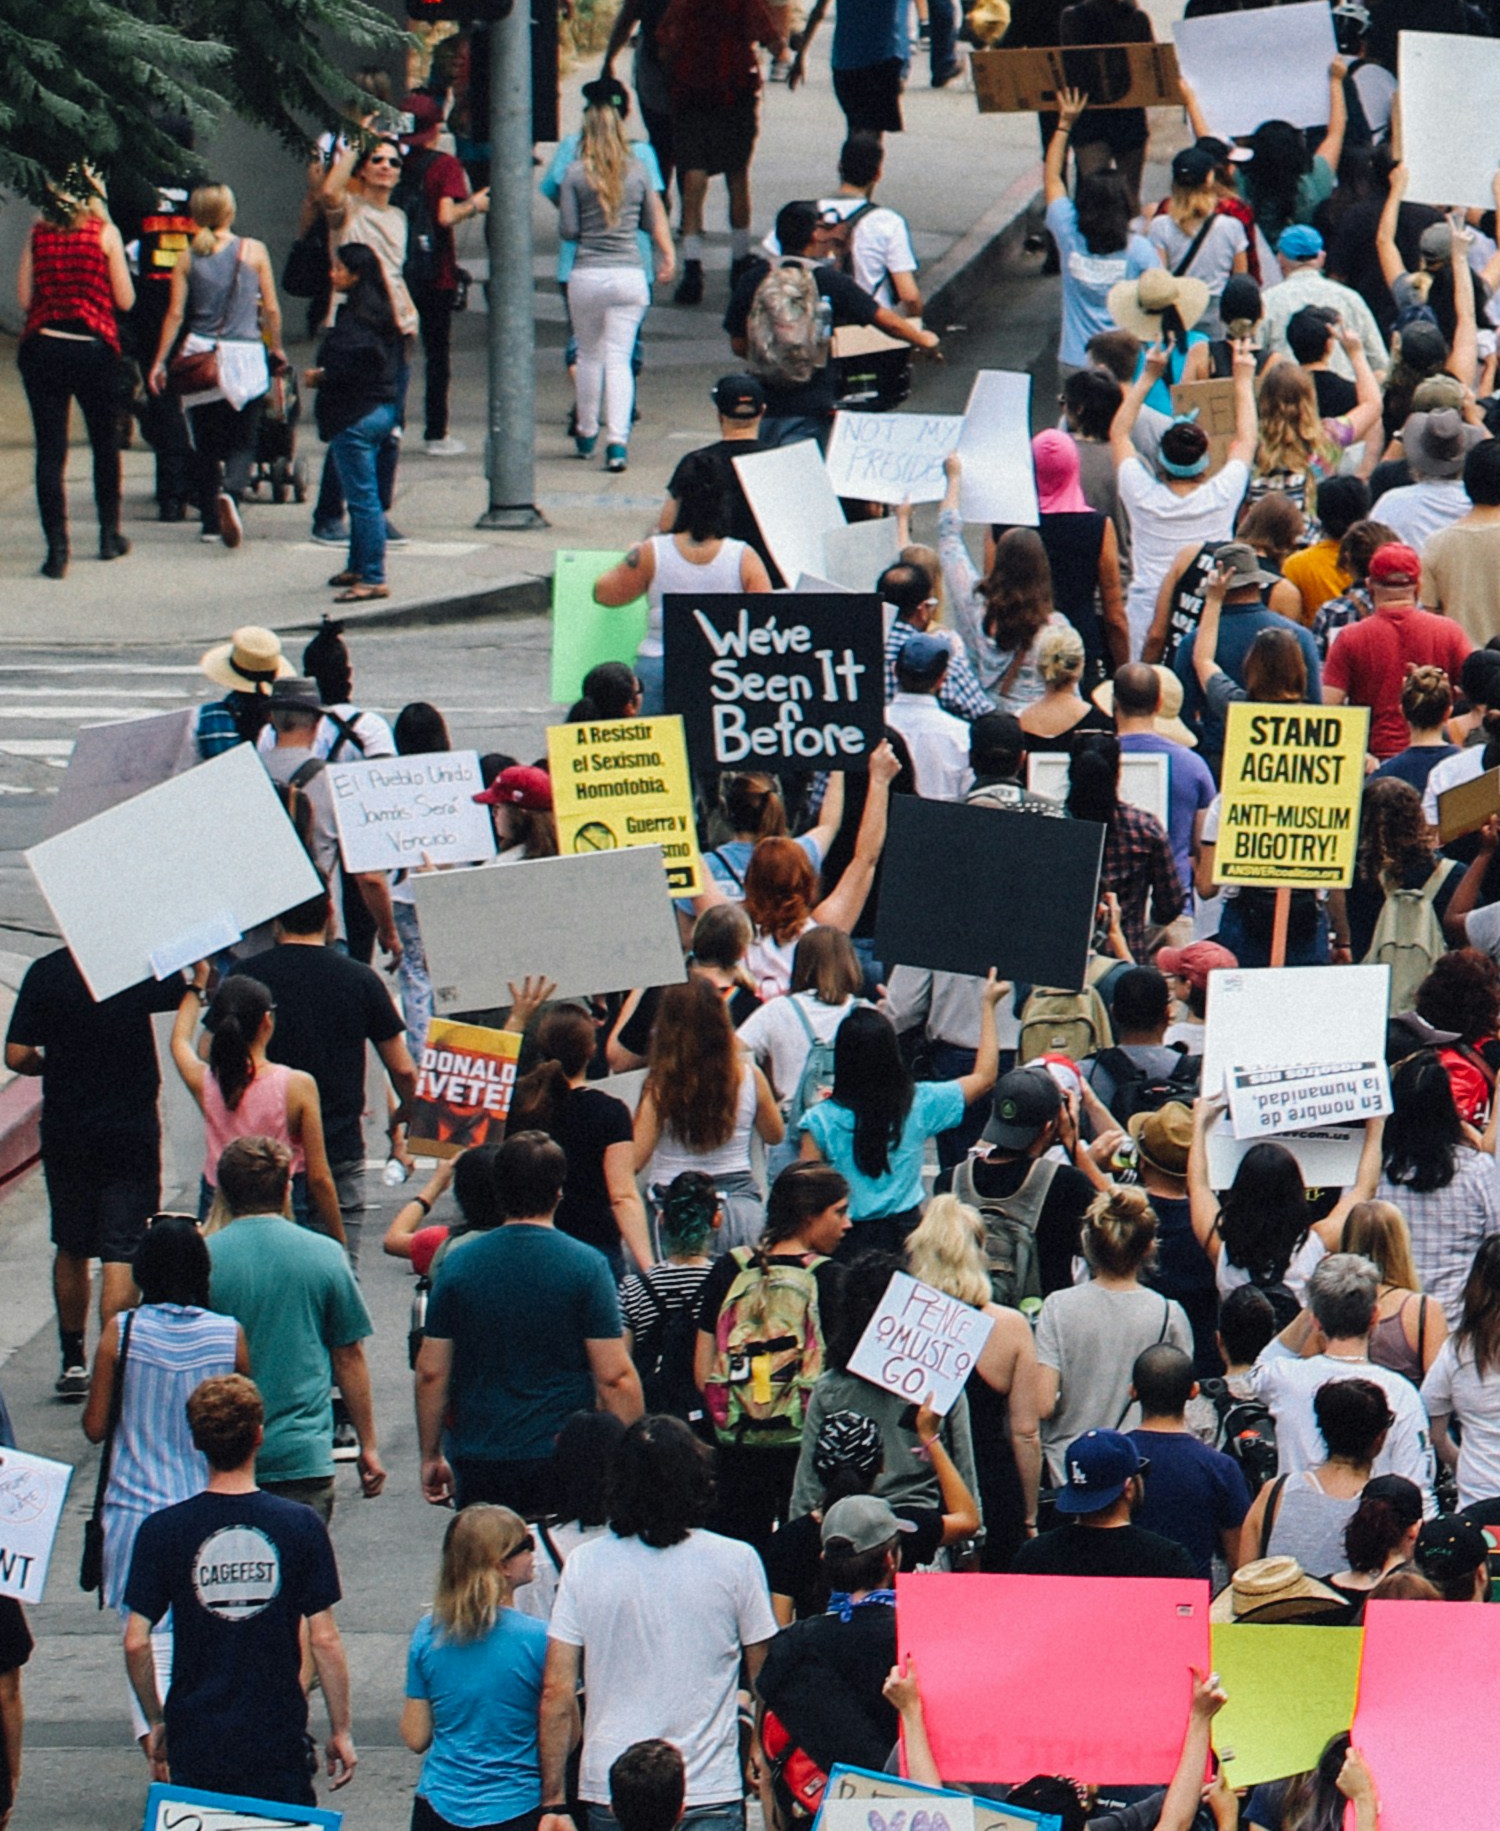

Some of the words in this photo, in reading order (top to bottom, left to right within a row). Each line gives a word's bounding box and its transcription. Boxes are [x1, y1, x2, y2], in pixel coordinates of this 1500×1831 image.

[693, 608, 811, 657] We've
[710, 659, 809, 702] Seen
[815, 648, 864, 701] It
[712, 701, 865, 763] Before
[1250, 716, 1341, 748] STAND
[1240, 754, 1346, 786] AGAINST
[1227, 804, 1350, 832] ANTI-MUSLIM
[1235, 833, 1338, 861] BIGOTRY!
[422, 1049, 516, 1083] DONALD
[415, 1074, 515, 1112] ¡VETE!
[903, 1283, 972, 1344] PENCE
[891, 1319, 955, 1380] MUST
[882, 1356, 928, 1394] GO
[200, 1560, 274, 1586] CAGEFEST
